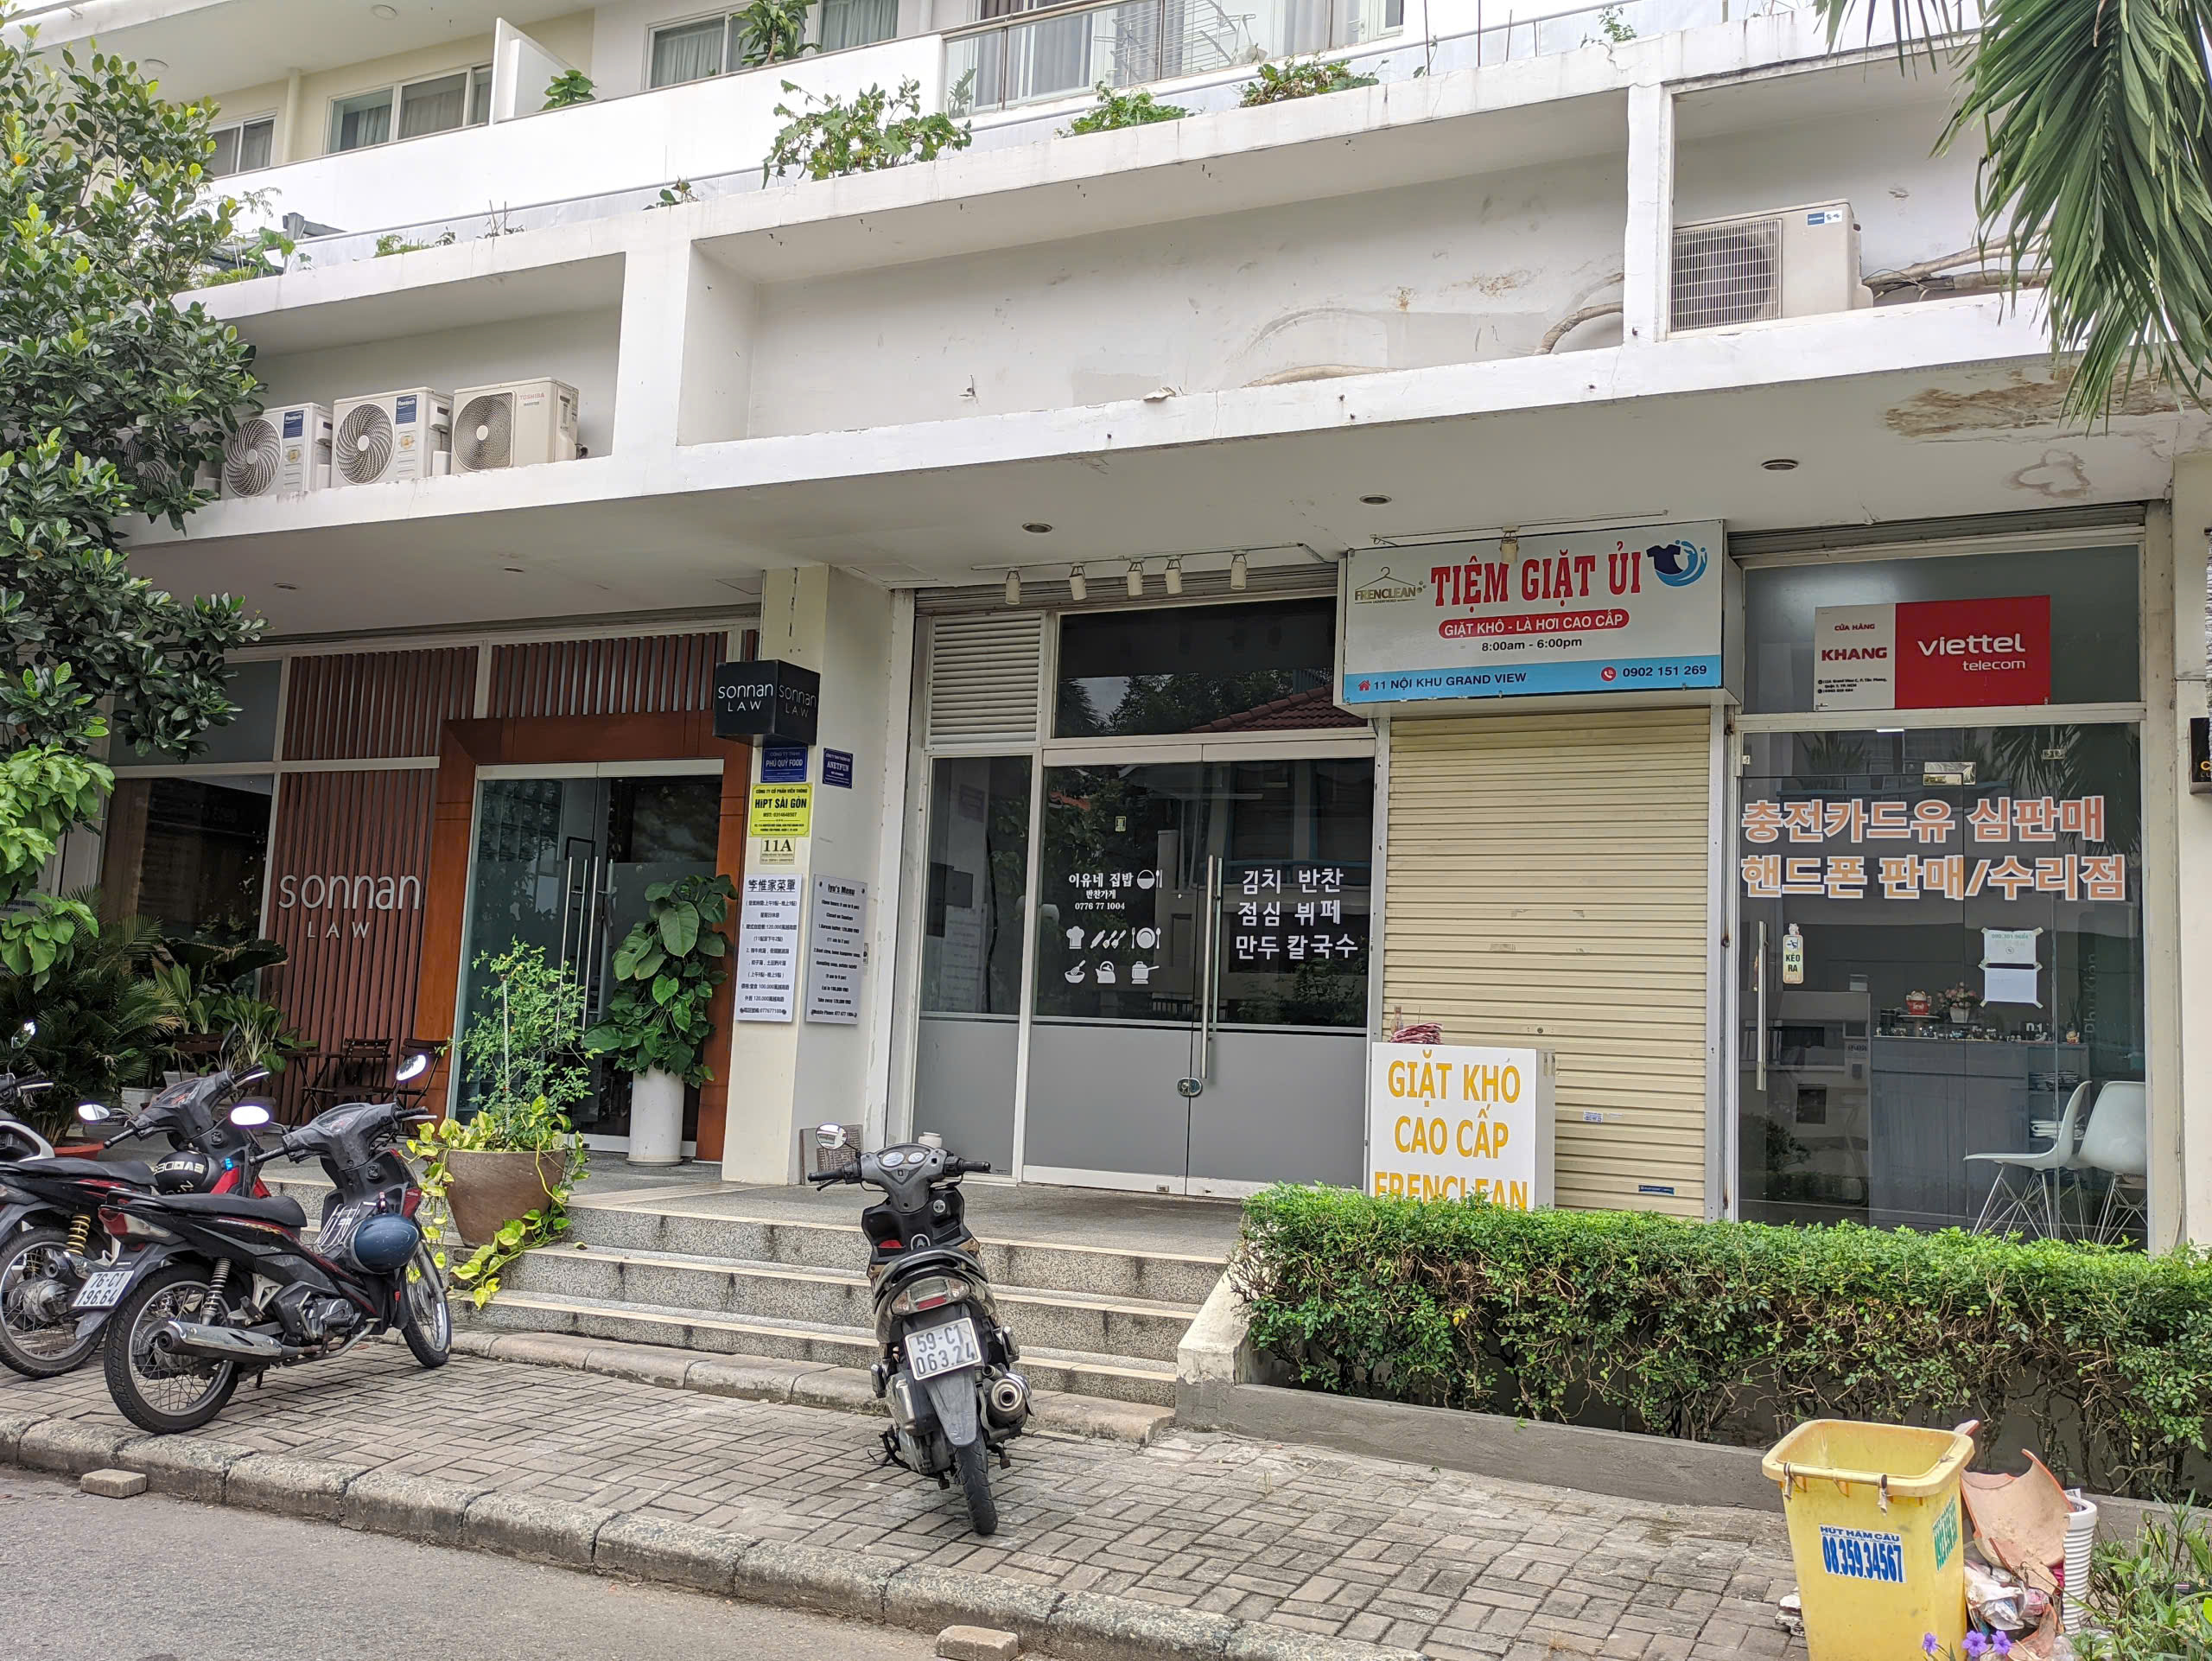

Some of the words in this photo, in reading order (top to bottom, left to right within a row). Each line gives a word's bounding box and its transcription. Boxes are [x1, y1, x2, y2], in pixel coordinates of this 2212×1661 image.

[1431, 555, 1509, 613] TIỆM
[1522, 550, 1595, 607] GIẶT
[1608, 541, 1641, 595] ỦI
[1355, 588, 1415, 601] FRENCLEAN
[1445, 621, 1474, 638] GIẶT
[1477, 620, 1504, 633] KHÔ
[1516, 617, 1532, 632] LÀ
[1536, 617, 1559, 631] HƠI
[1563, 616, 1592, 628] CAO
[1596, 609, 1623, 627] CẤP
[1853, 622, 1875, 631] HÀNG
[1481, 641, 1525, 652] 8:00am
[1537, 639, 1582, 649] 6:00pm
[1821, 646, 1887, 661] KHANG
[1917, 633, 2025, 657] viettel
[1623, 667, 1653, 678] 0902
[1658, 665, 1679, 677] 151
[1683, 665, 1707, 676] 269
[1962, 659, 2025, 671] telecom
[1374, 681, 1386, 690] 11
[1391, 678, 1412, 690] NỘI
[1417, 678, 1442, 687] KHU
[1446, 675, 1491, 686] GRAND
[1495, 672, 1527, 684] VIEW
[718, 683, 773, 699] sonnan
[779, 684, 817, 708] sonnan
[728, 700, 761, 712] LAW
[785, 703, 809, 718] LAW
[790, 795, 807, 809] GÒN
[1742, 798, 1955, 843] 충전카드유
[1967, 795, 2105, 843] 심판매
[764, 839, 792, 852] 11A
[1069, 873, 1103, 888] 이유네
[1109, 873, 1134, 888] 집밥
[1242, 869, 1281, 895] 김치
[1299, 868, 1344, 894] 반찬
[1741, 854, 1868, 899] 핸드폰
[1878, 854, 2126, 901] 판매/수리점
[278, 875, 421, 910] sonnan
[1086, 889, 1116, 900] 반찬가게
[1237, 901, 1281, 927] 점심
[1294, 900, 1341, 926] 뷔페
[308, 921, 371, 939] LAW
[1236, 935, 1280, 960] 만두
[1287, 933, 1359, 959] 칼국수
[1785, 952, 1801, 963] KÉO
[1388, 1049, 1452, 1108] GIẶT
[1395, 1116, 1448, 1155] CAO
[1457, 1104, 1509, 1159] CẤP
[91, 1272, 125, 1289] 76-C1
[77, 1289, 118, 1306] 196.64
[916, 1324, 963, 1353] 59-C1
[916, 1343, 976, 1375] 063.24
[1822, 1536, 1903, 1583] 08.359.34567
